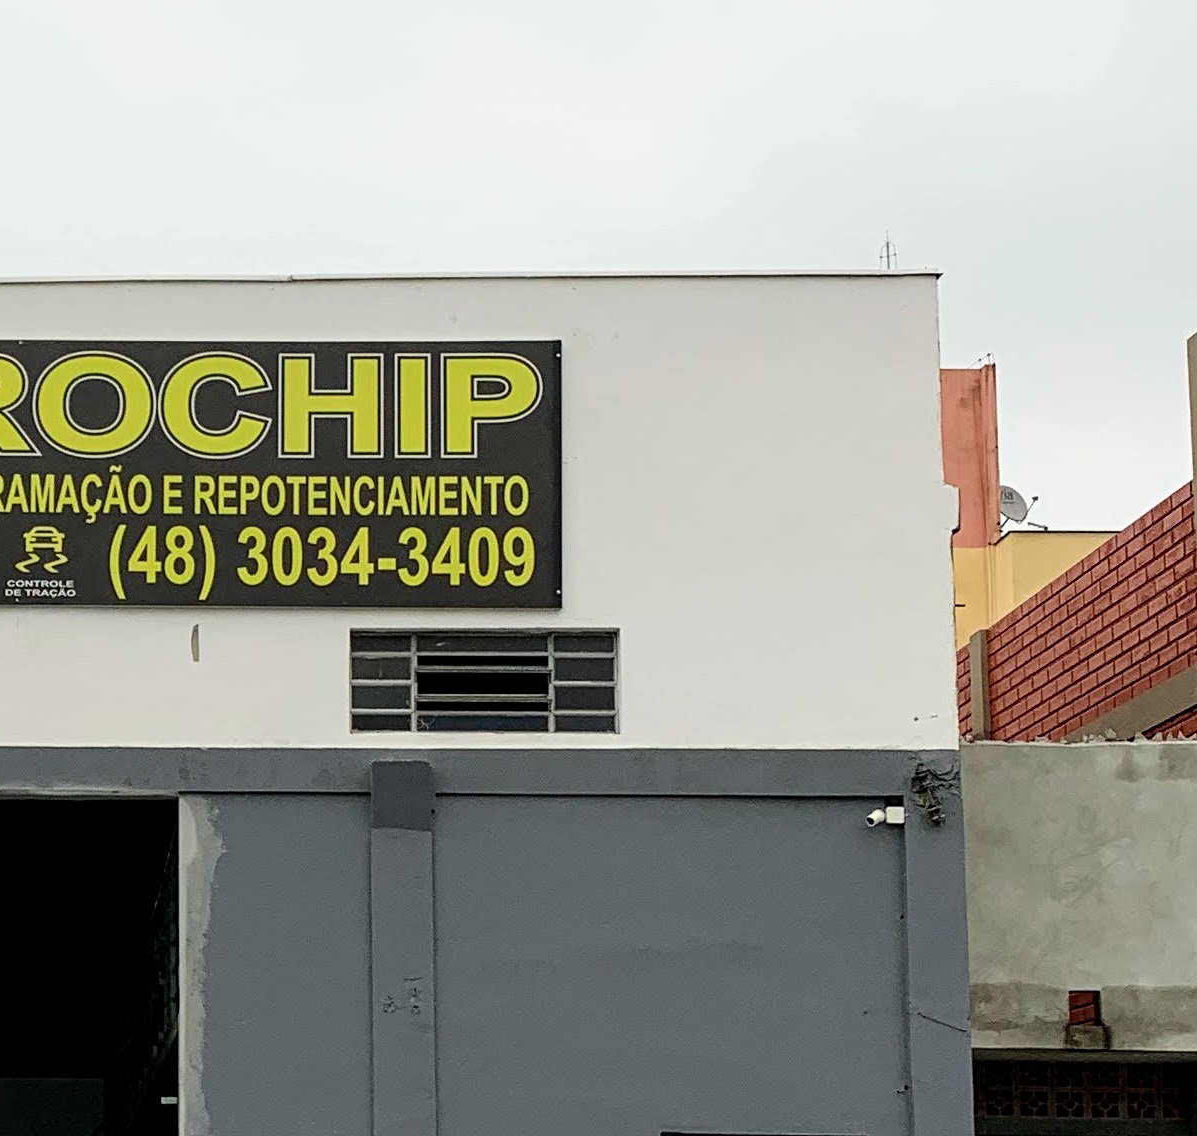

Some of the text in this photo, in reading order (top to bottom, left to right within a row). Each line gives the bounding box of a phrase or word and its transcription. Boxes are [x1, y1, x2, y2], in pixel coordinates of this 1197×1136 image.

[163, 475, 183, 515] E
[194, 475, 530, 516] REPOTENCIAMENTO
[109, 524, 535, 600] (48) 3034-3409
[4, 588, 77, 598] DE TRAÇÃO
[6, 579, 74, 588] CONTROLE
